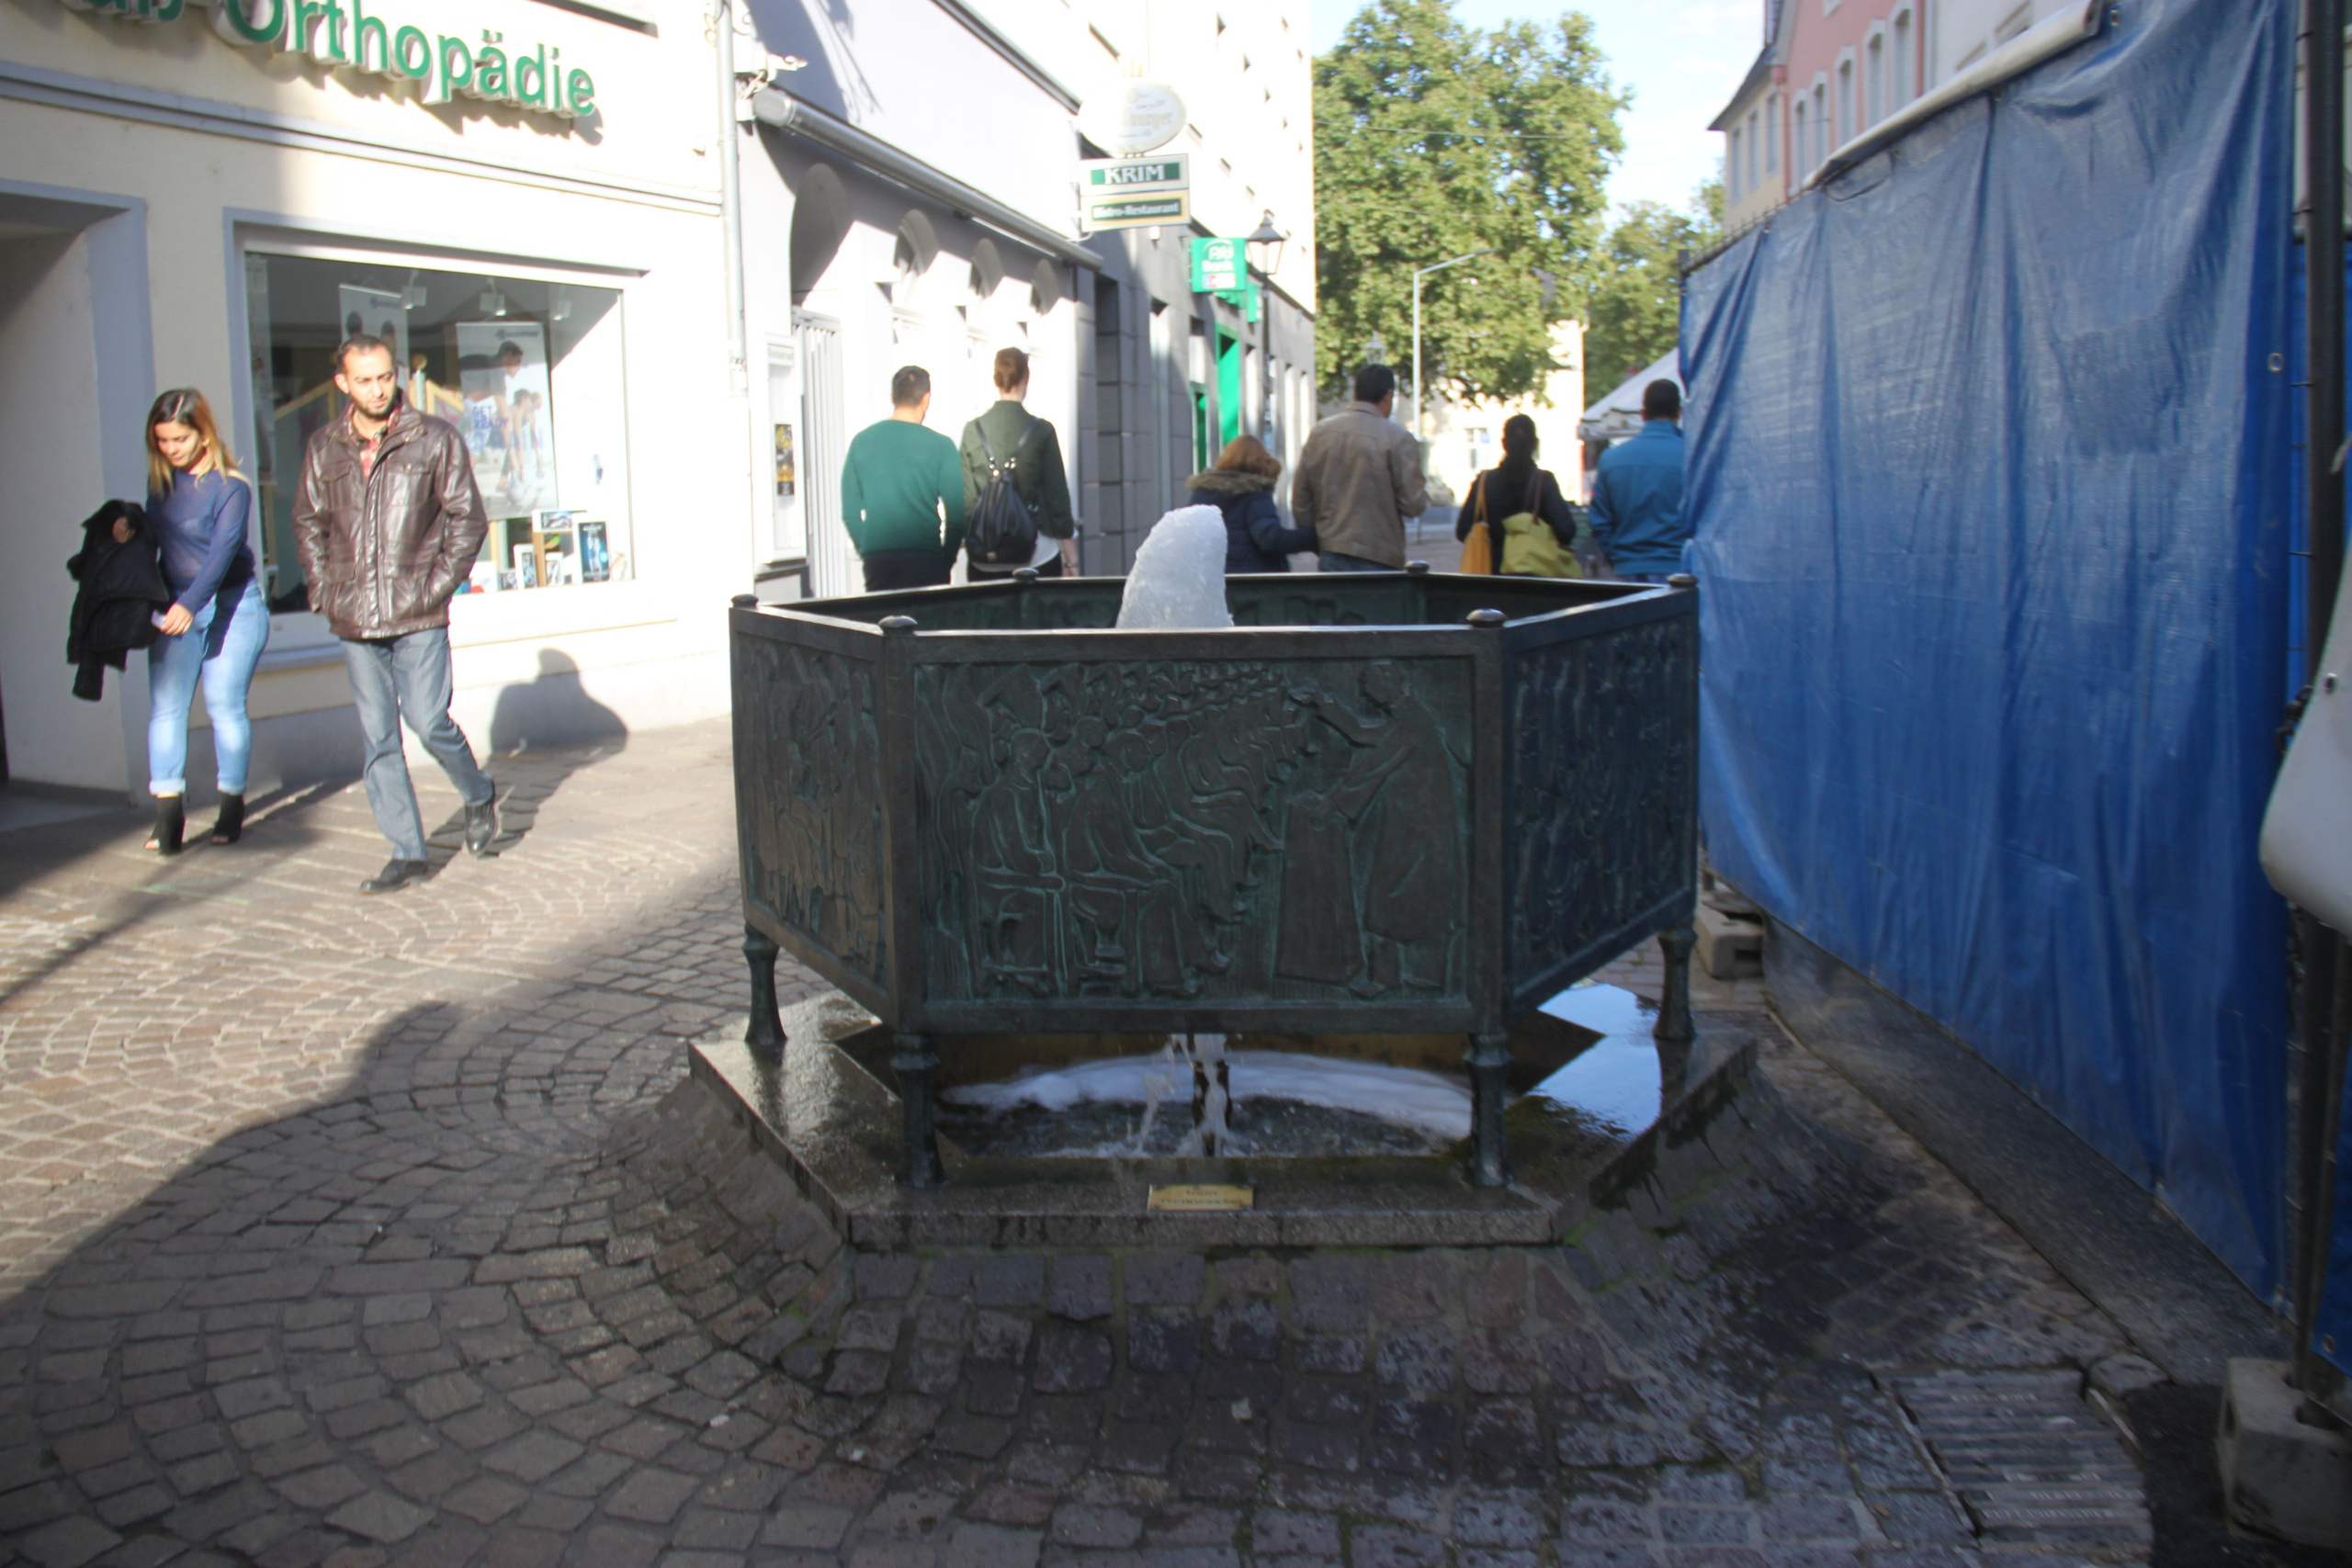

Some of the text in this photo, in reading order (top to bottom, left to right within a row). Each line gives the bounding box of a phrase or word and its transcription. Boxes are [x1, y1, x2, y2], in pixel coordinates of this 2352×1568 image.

[220, 0, 597, 116] Orthopädie
[1103, 164, 1165, 184] KRIM
[1202, 260, 1234, 272] Bank
[472, 406, 492, 418] GET
